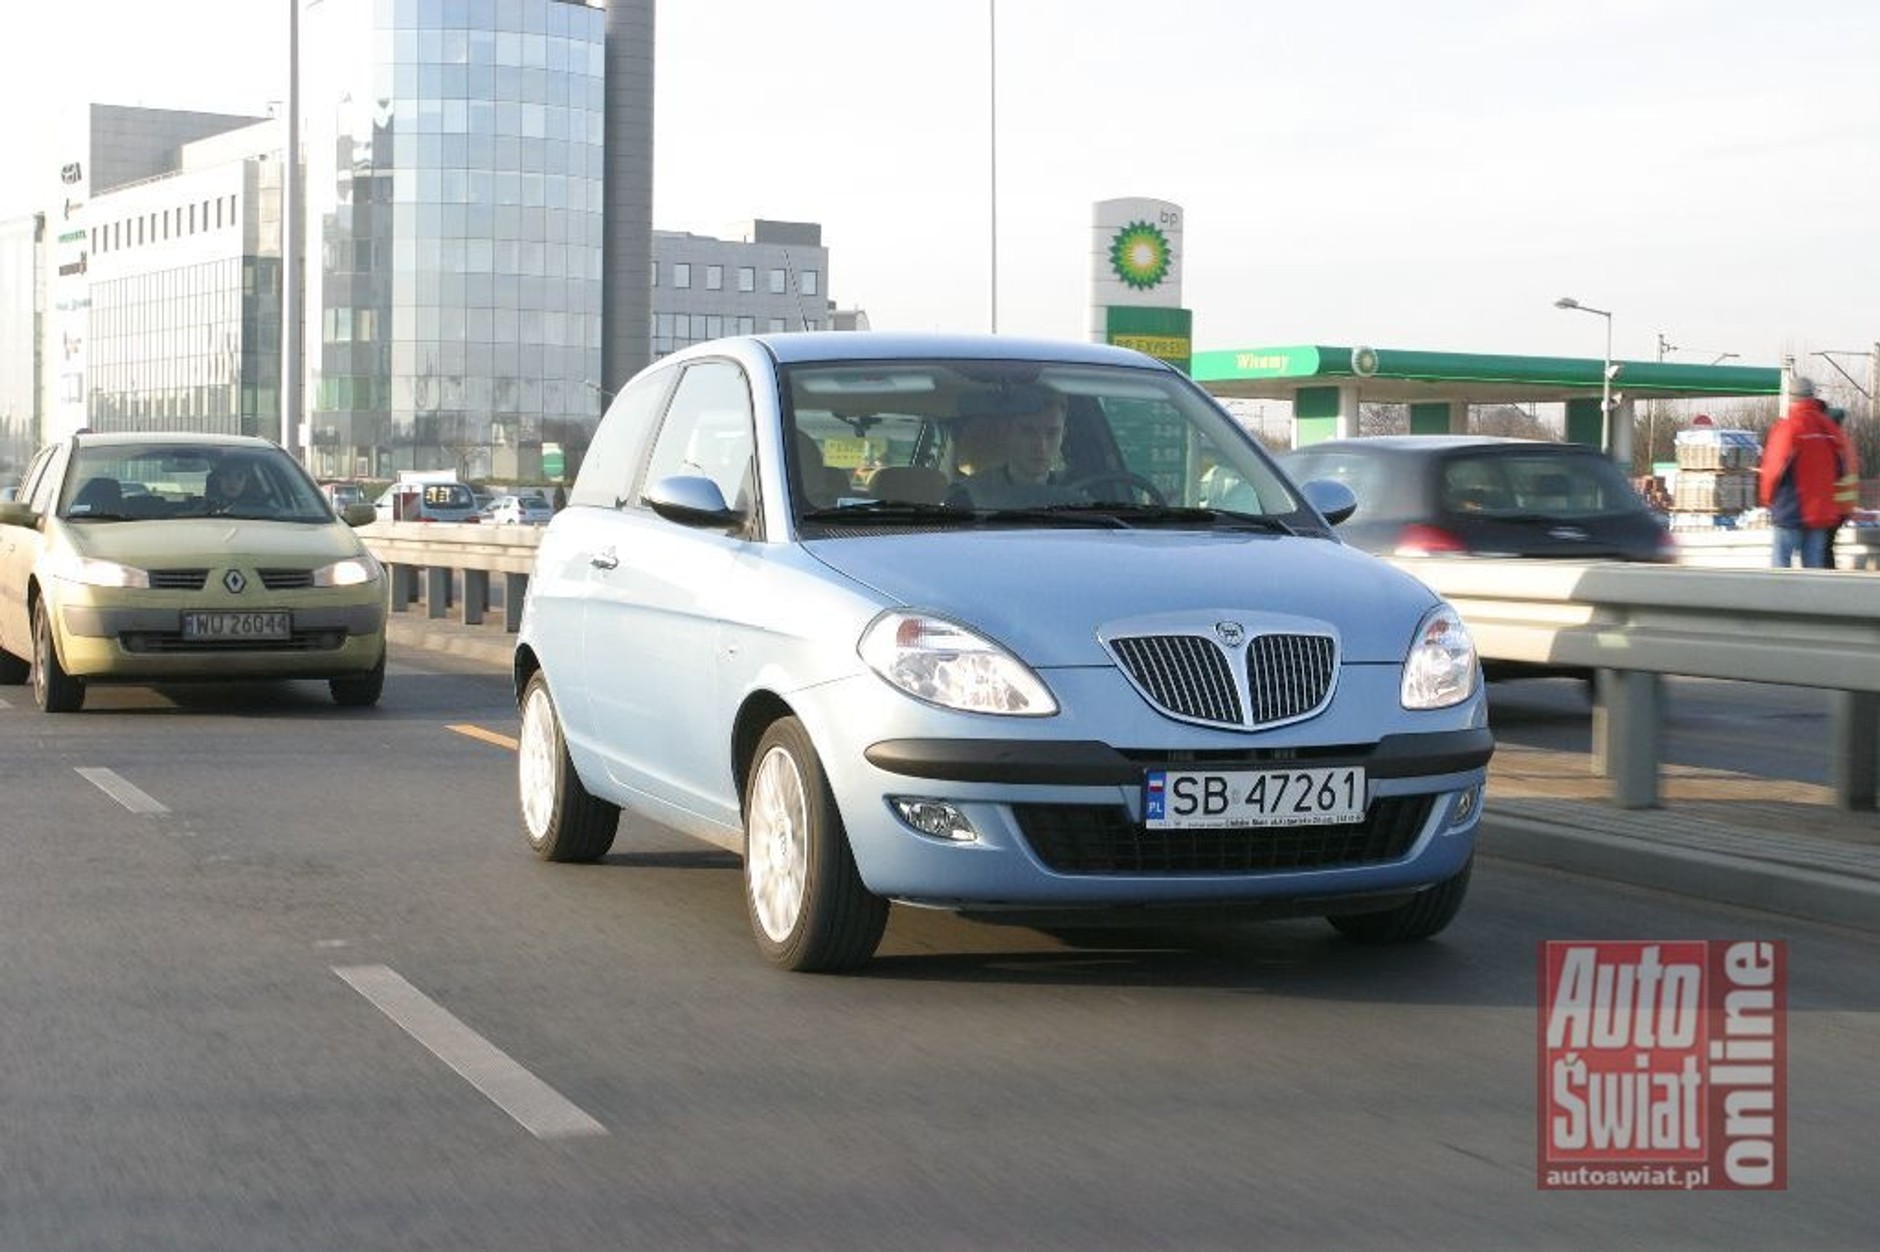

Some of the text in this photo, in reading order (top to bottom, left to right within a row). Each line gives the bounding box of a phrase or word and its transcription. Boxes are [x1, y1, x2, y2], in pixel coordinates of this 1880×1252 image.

[1160, 209, 1178, 227] bp
[196, 614, 288, 634] WU 26044
[1172, 770, 1356, 816] SB 47261
[1148, 802, 1162, 814] PL
